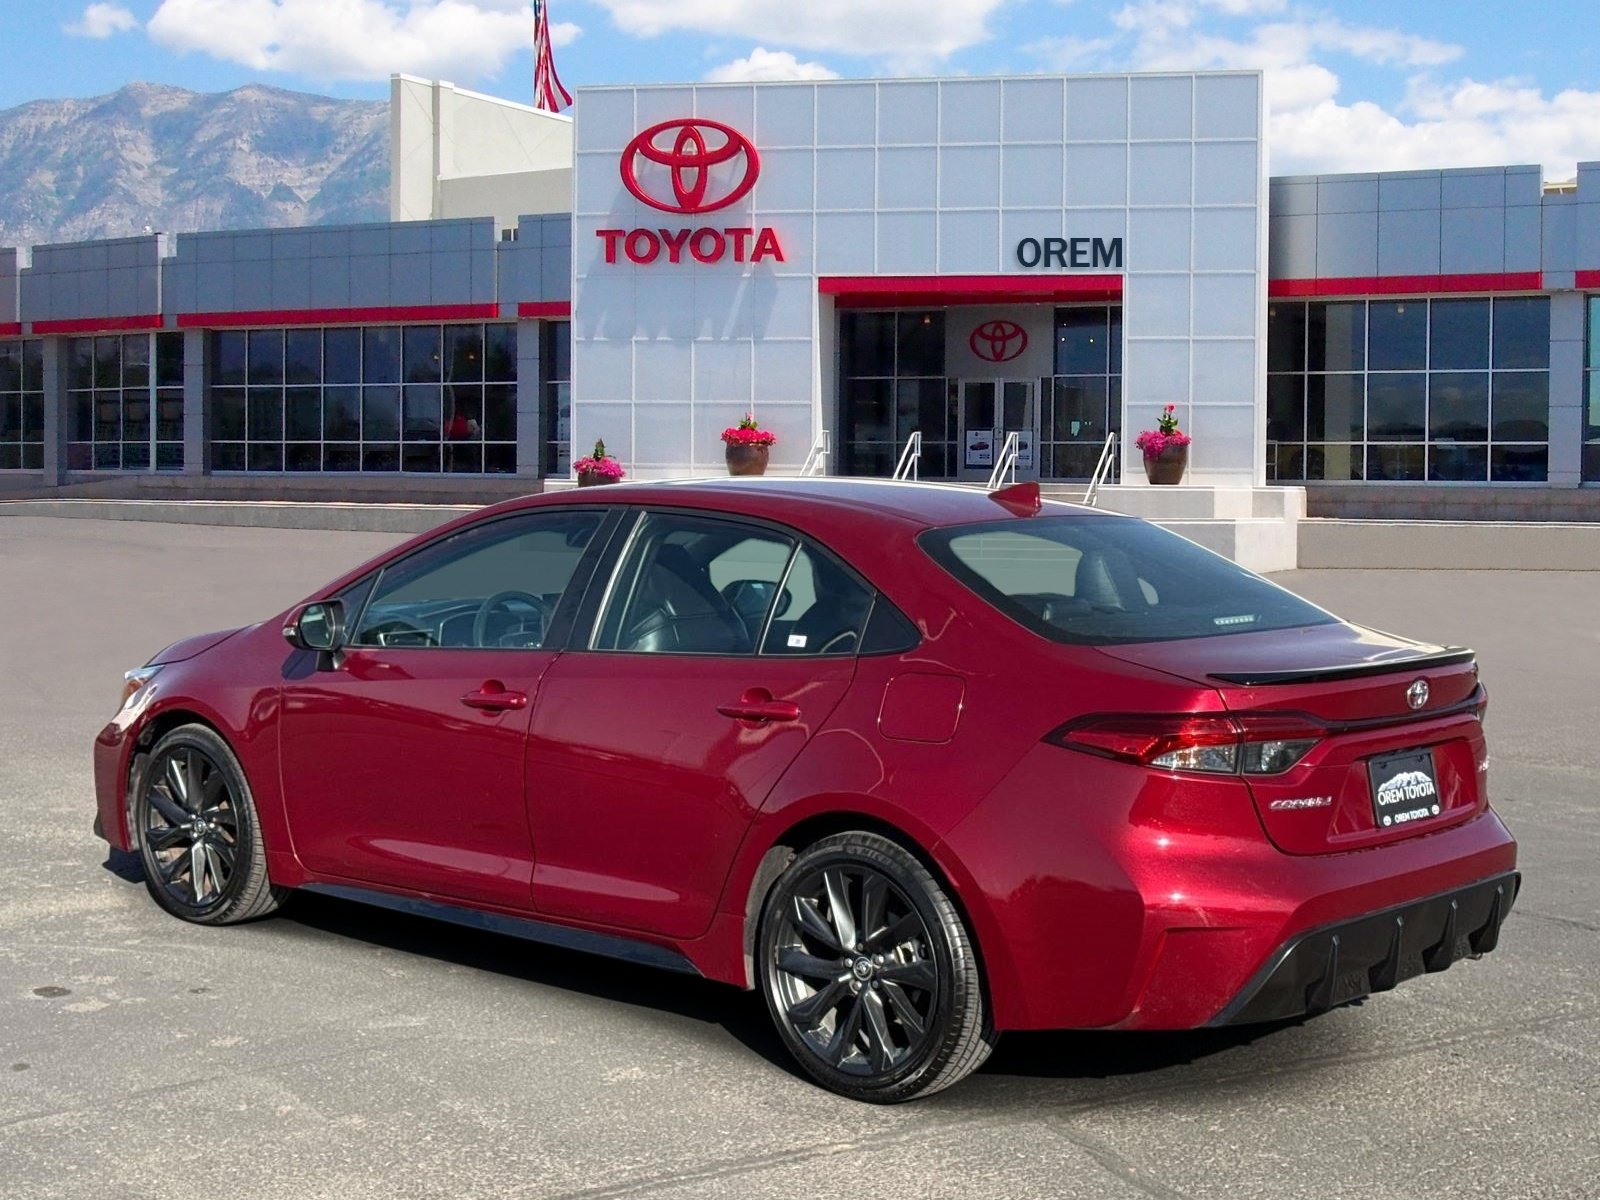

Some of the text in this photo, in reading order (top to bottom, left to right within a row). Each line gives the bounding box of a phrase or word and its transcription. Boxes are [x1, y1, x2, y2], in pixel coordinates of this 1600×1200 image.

[596, 227, 785, 264] TOYOTA
[1017, 237, 1123, 268] OREM
[1377, 781, 1435, 806] OREM TOYOTA
[1394, 808, 1430, 823] OREM TOYOTA
